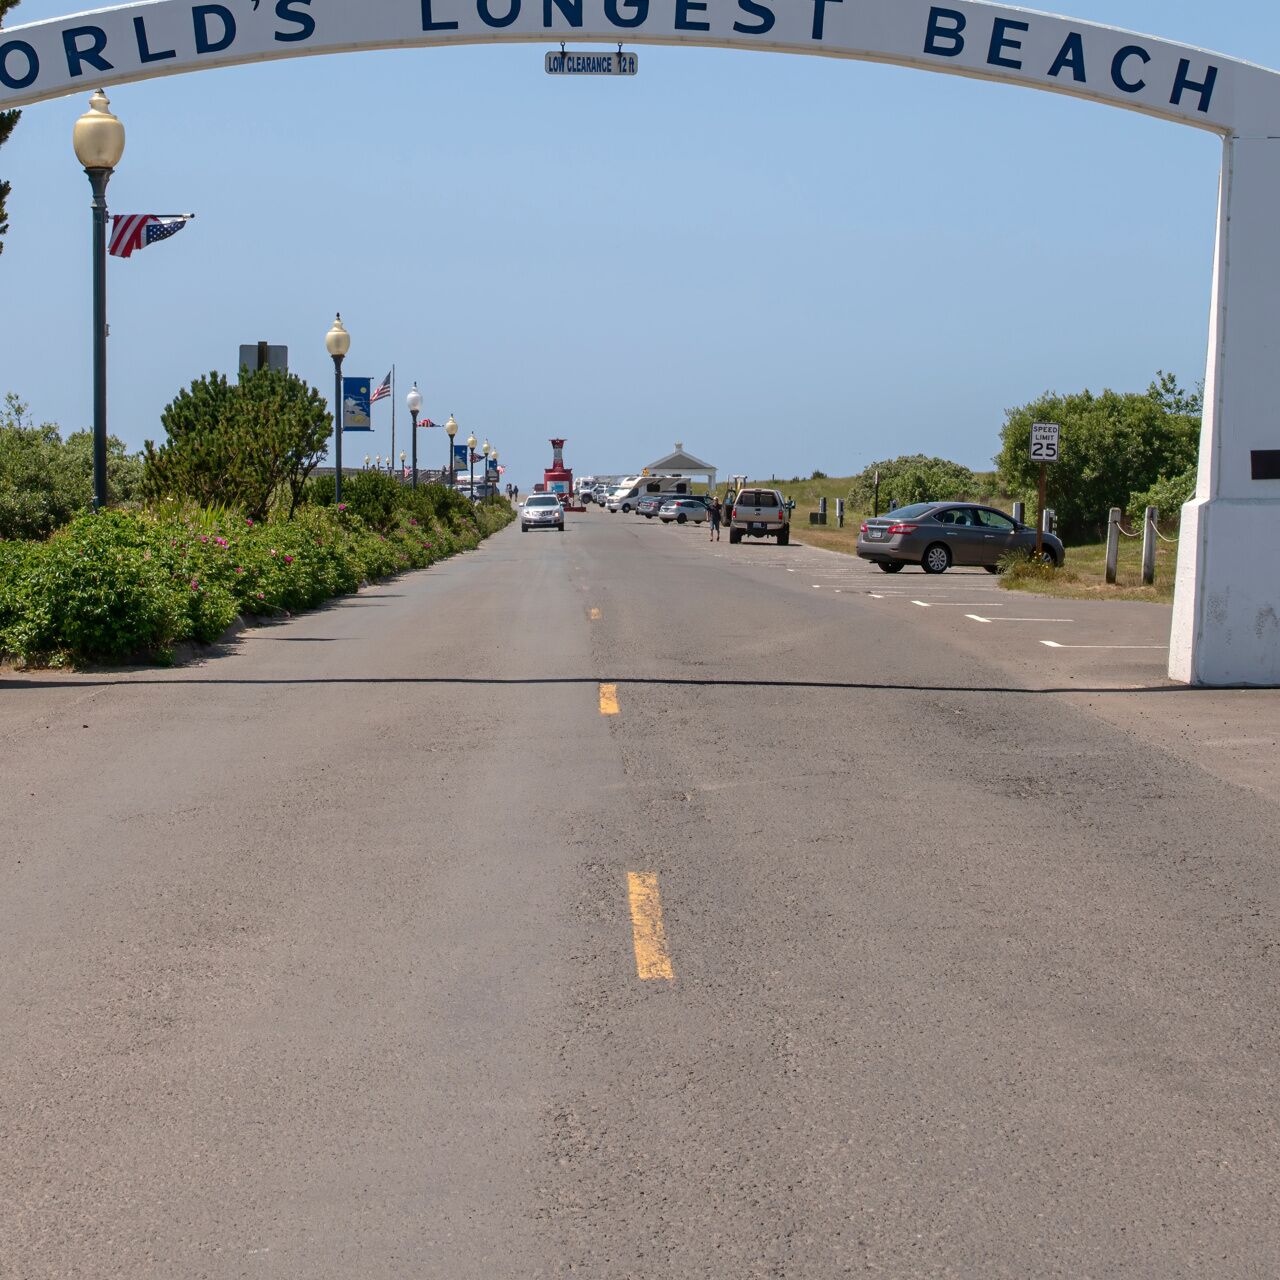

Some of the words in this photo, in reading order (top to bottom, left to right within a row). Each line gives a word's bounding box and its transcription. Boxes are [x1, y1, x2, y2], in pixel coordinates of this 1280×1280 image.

[548, 56, 565, 72] LOW
[567, 56, 612, 72] CLEARANCE
[618, 56, 627, 72] 12
[923, 6, 1218, 113] BEACH
[1032, 442, 1057, 457] 25
